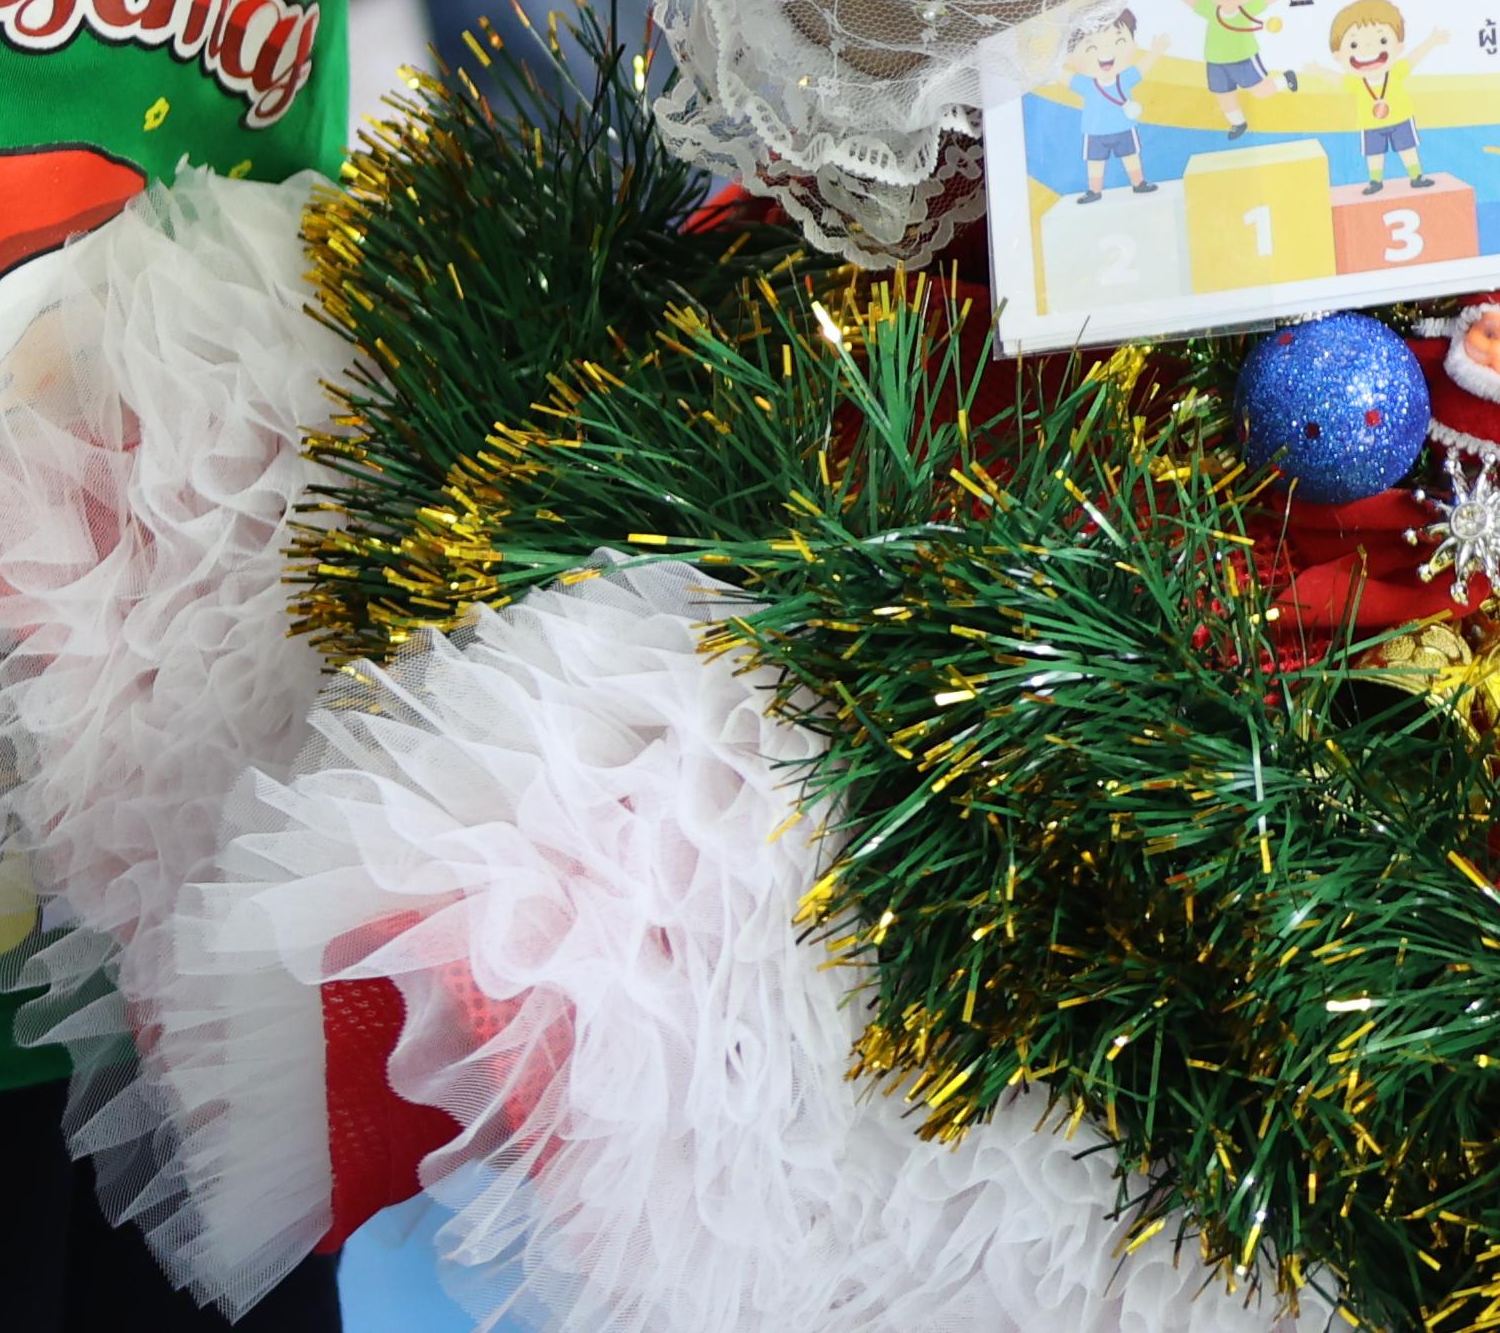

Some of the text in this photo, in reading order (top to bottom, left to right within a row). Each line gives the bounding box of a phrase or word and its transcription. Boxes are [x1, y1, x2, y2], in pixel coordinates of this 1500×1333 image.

[1099, 204, 1425, 286] 2 1 3
